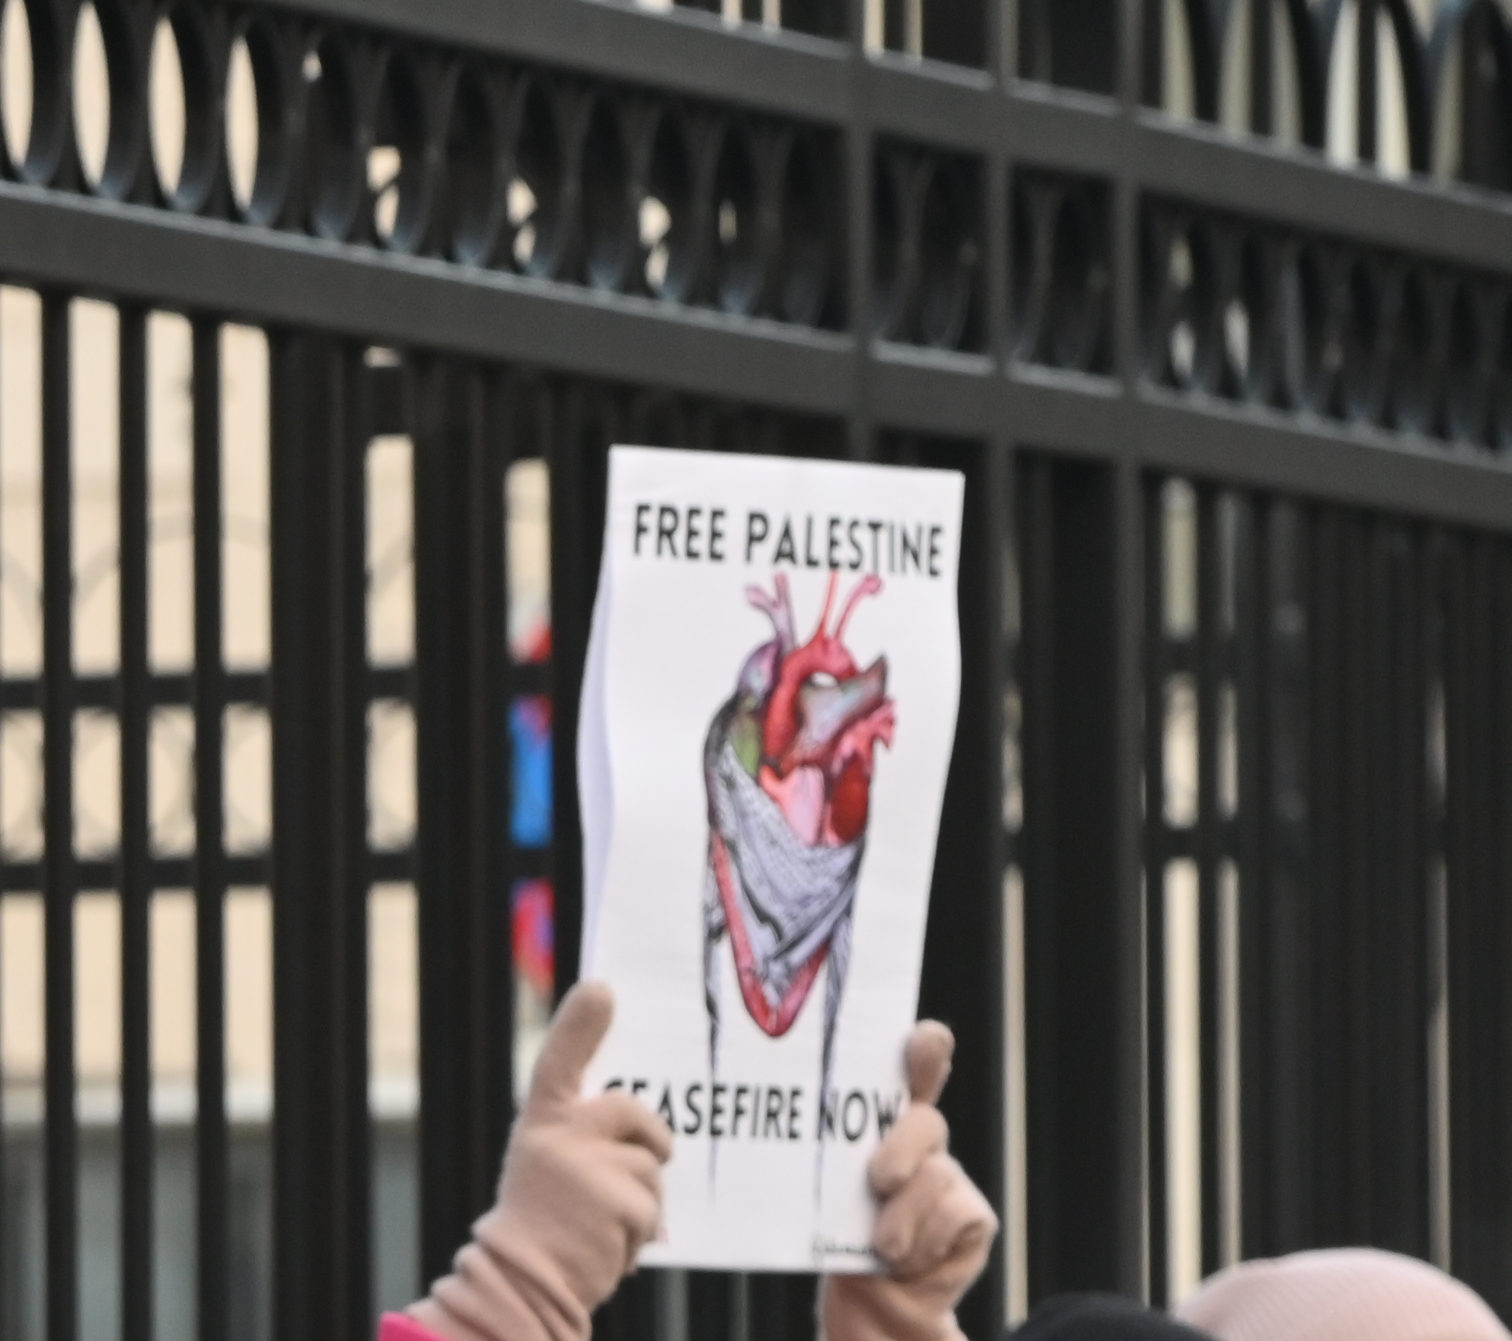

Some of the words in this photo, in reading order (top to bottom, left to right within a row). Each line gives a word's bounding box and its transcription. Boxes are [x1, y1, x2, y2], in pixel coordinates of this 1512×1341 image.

[632, 502, 727, 562] FREE
[745, 511, 943, 578] PALESTINE
[604, 1077, 804, 1140] ASEFIRE
